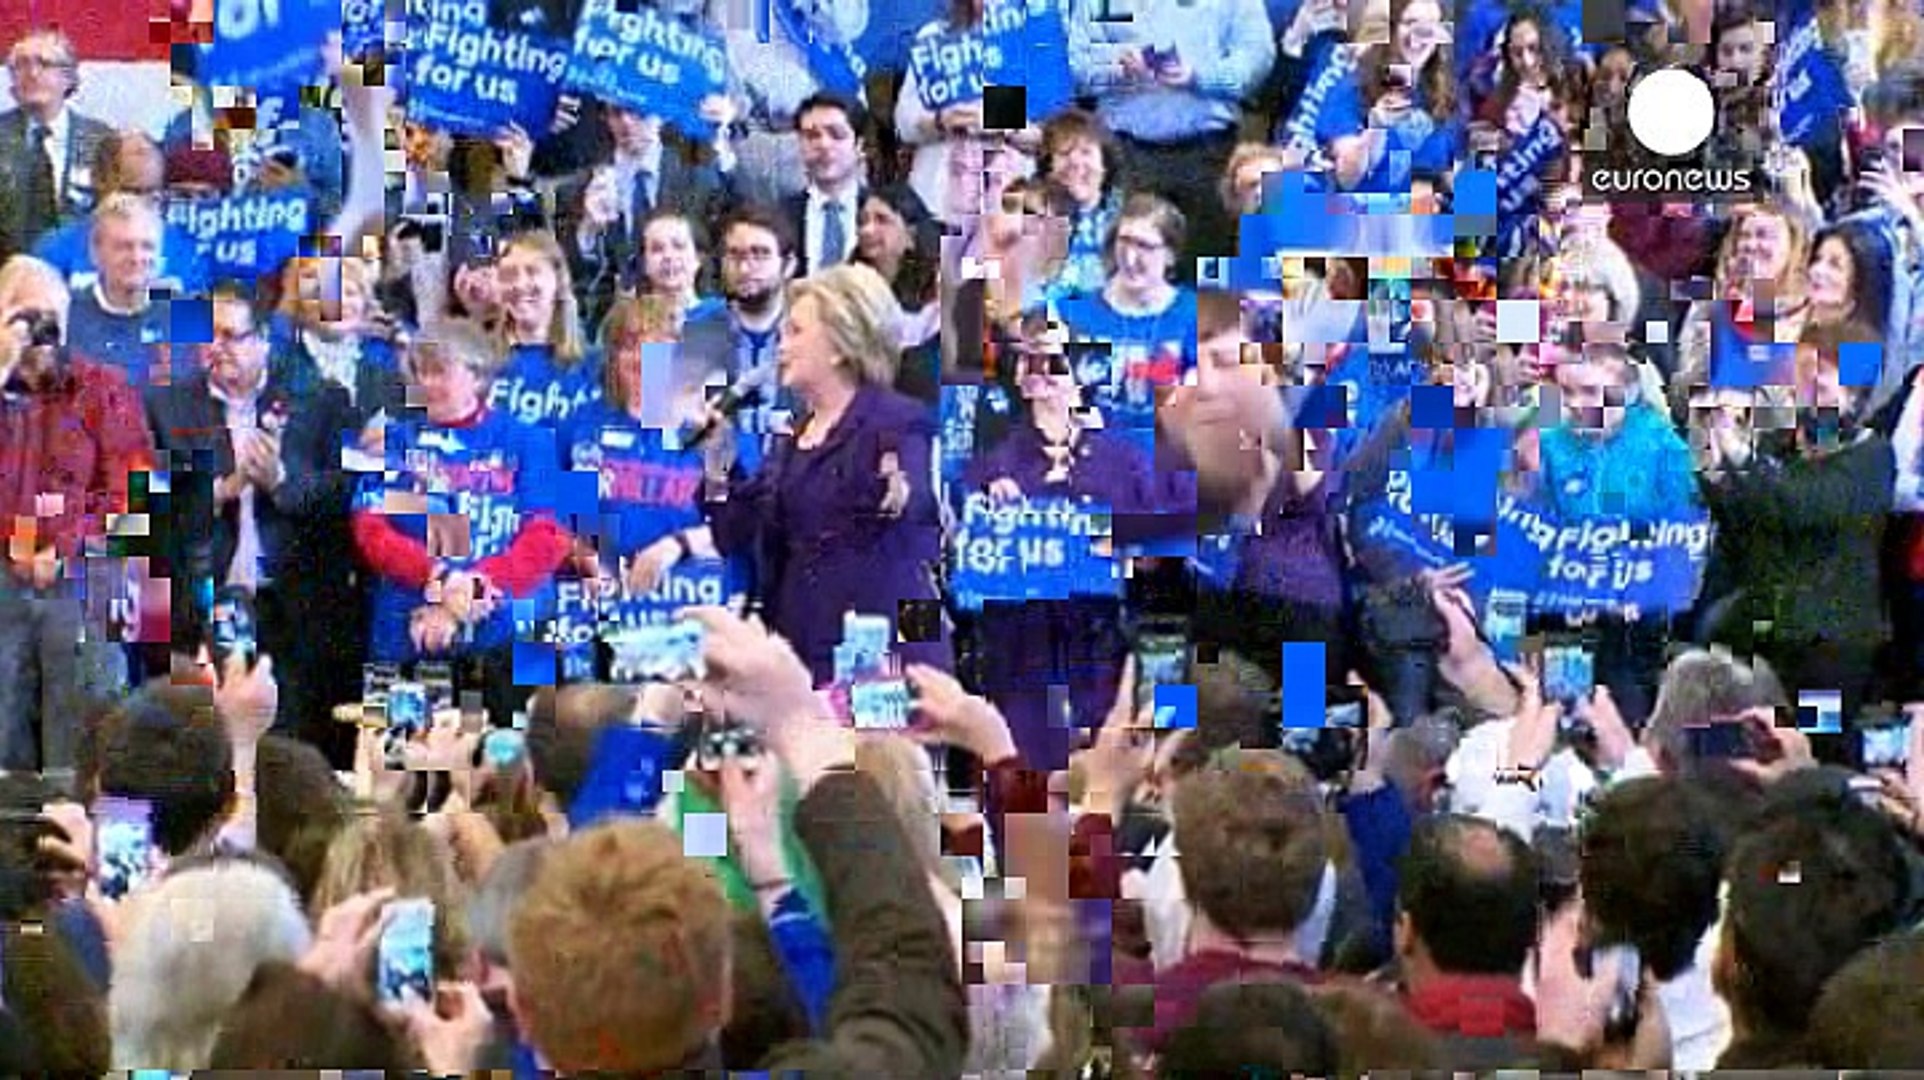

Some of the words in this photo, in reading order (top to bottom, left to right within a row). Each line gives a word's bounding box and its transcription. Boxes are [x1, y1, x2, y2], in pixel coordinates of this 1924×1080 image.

[427, 22, 567, 83] Fighting
[637, 50, 680, 85] us
[415, 54, 471, 93] for
[474, 72, 519, 105] us
[215, 239, 257, 267] us
[1018, 537, 1065, 575] us
